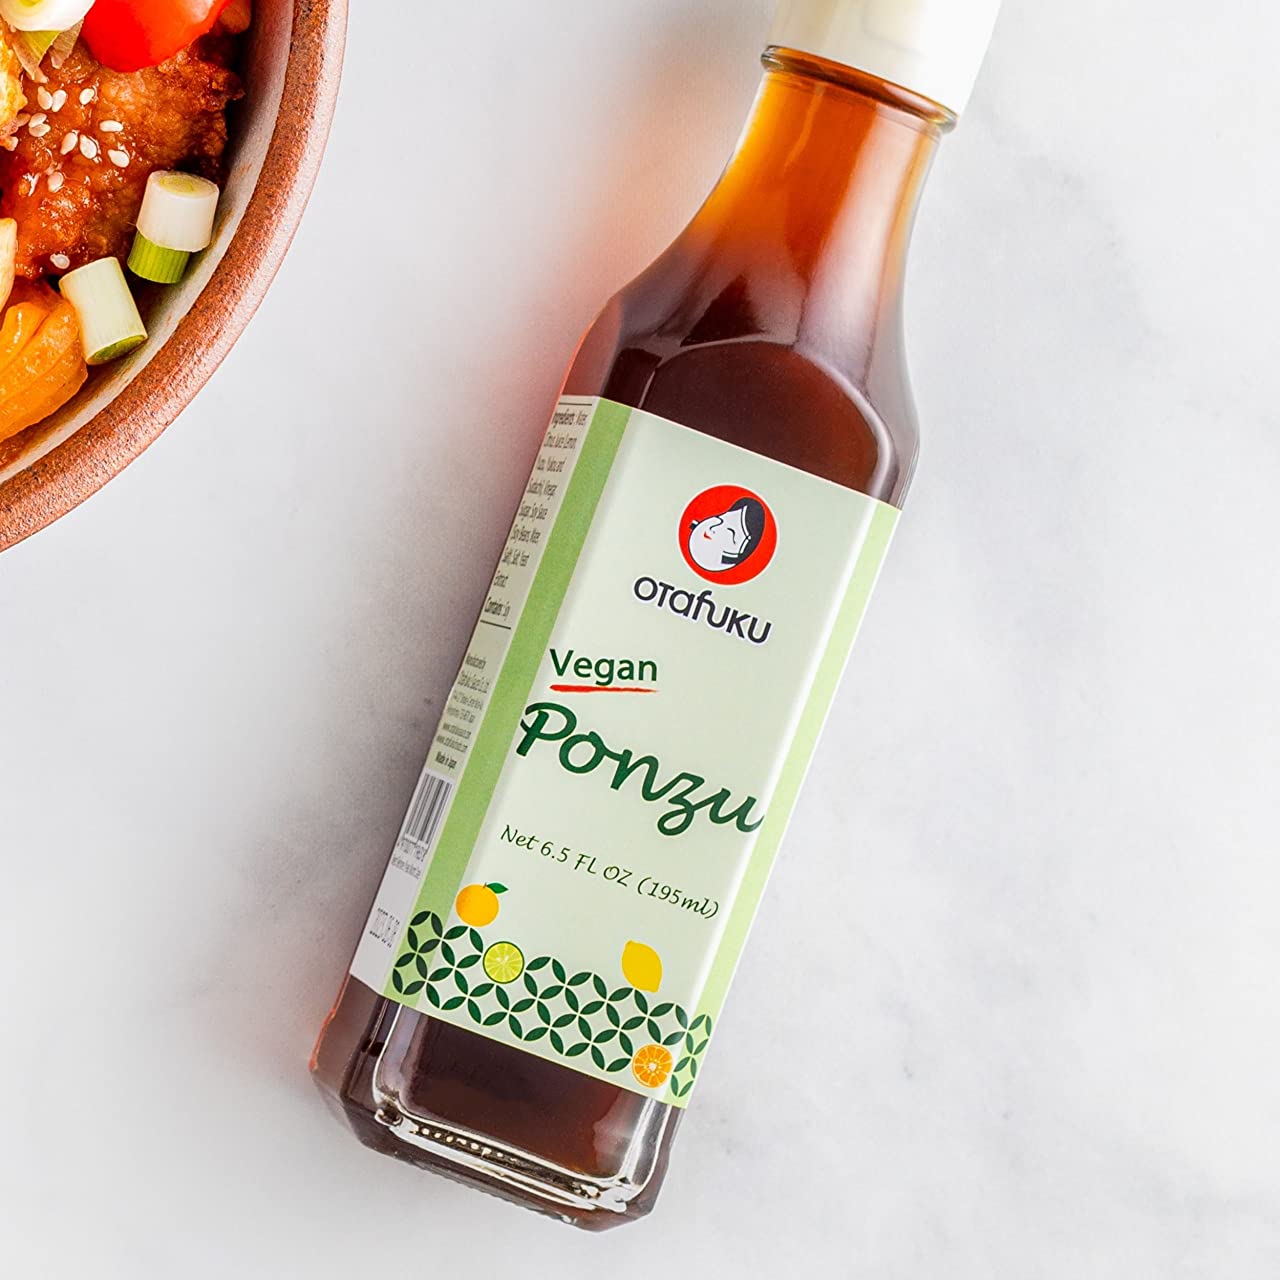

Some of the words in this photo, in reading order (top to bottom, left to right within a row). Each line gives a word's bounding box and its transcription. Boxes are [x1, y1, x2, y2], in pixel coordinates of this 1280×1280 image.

[549, 648, 658, 686] Vegan
[516, 702, 765, 836] Ponzu
[500, 824, 539, 850] Net
[540, 841, 571, 863] 6.5
[573, 853, 597, 874] FL
[603, 865, 633, 887] OZ
[637, 876, 719, 919] (195ml)
